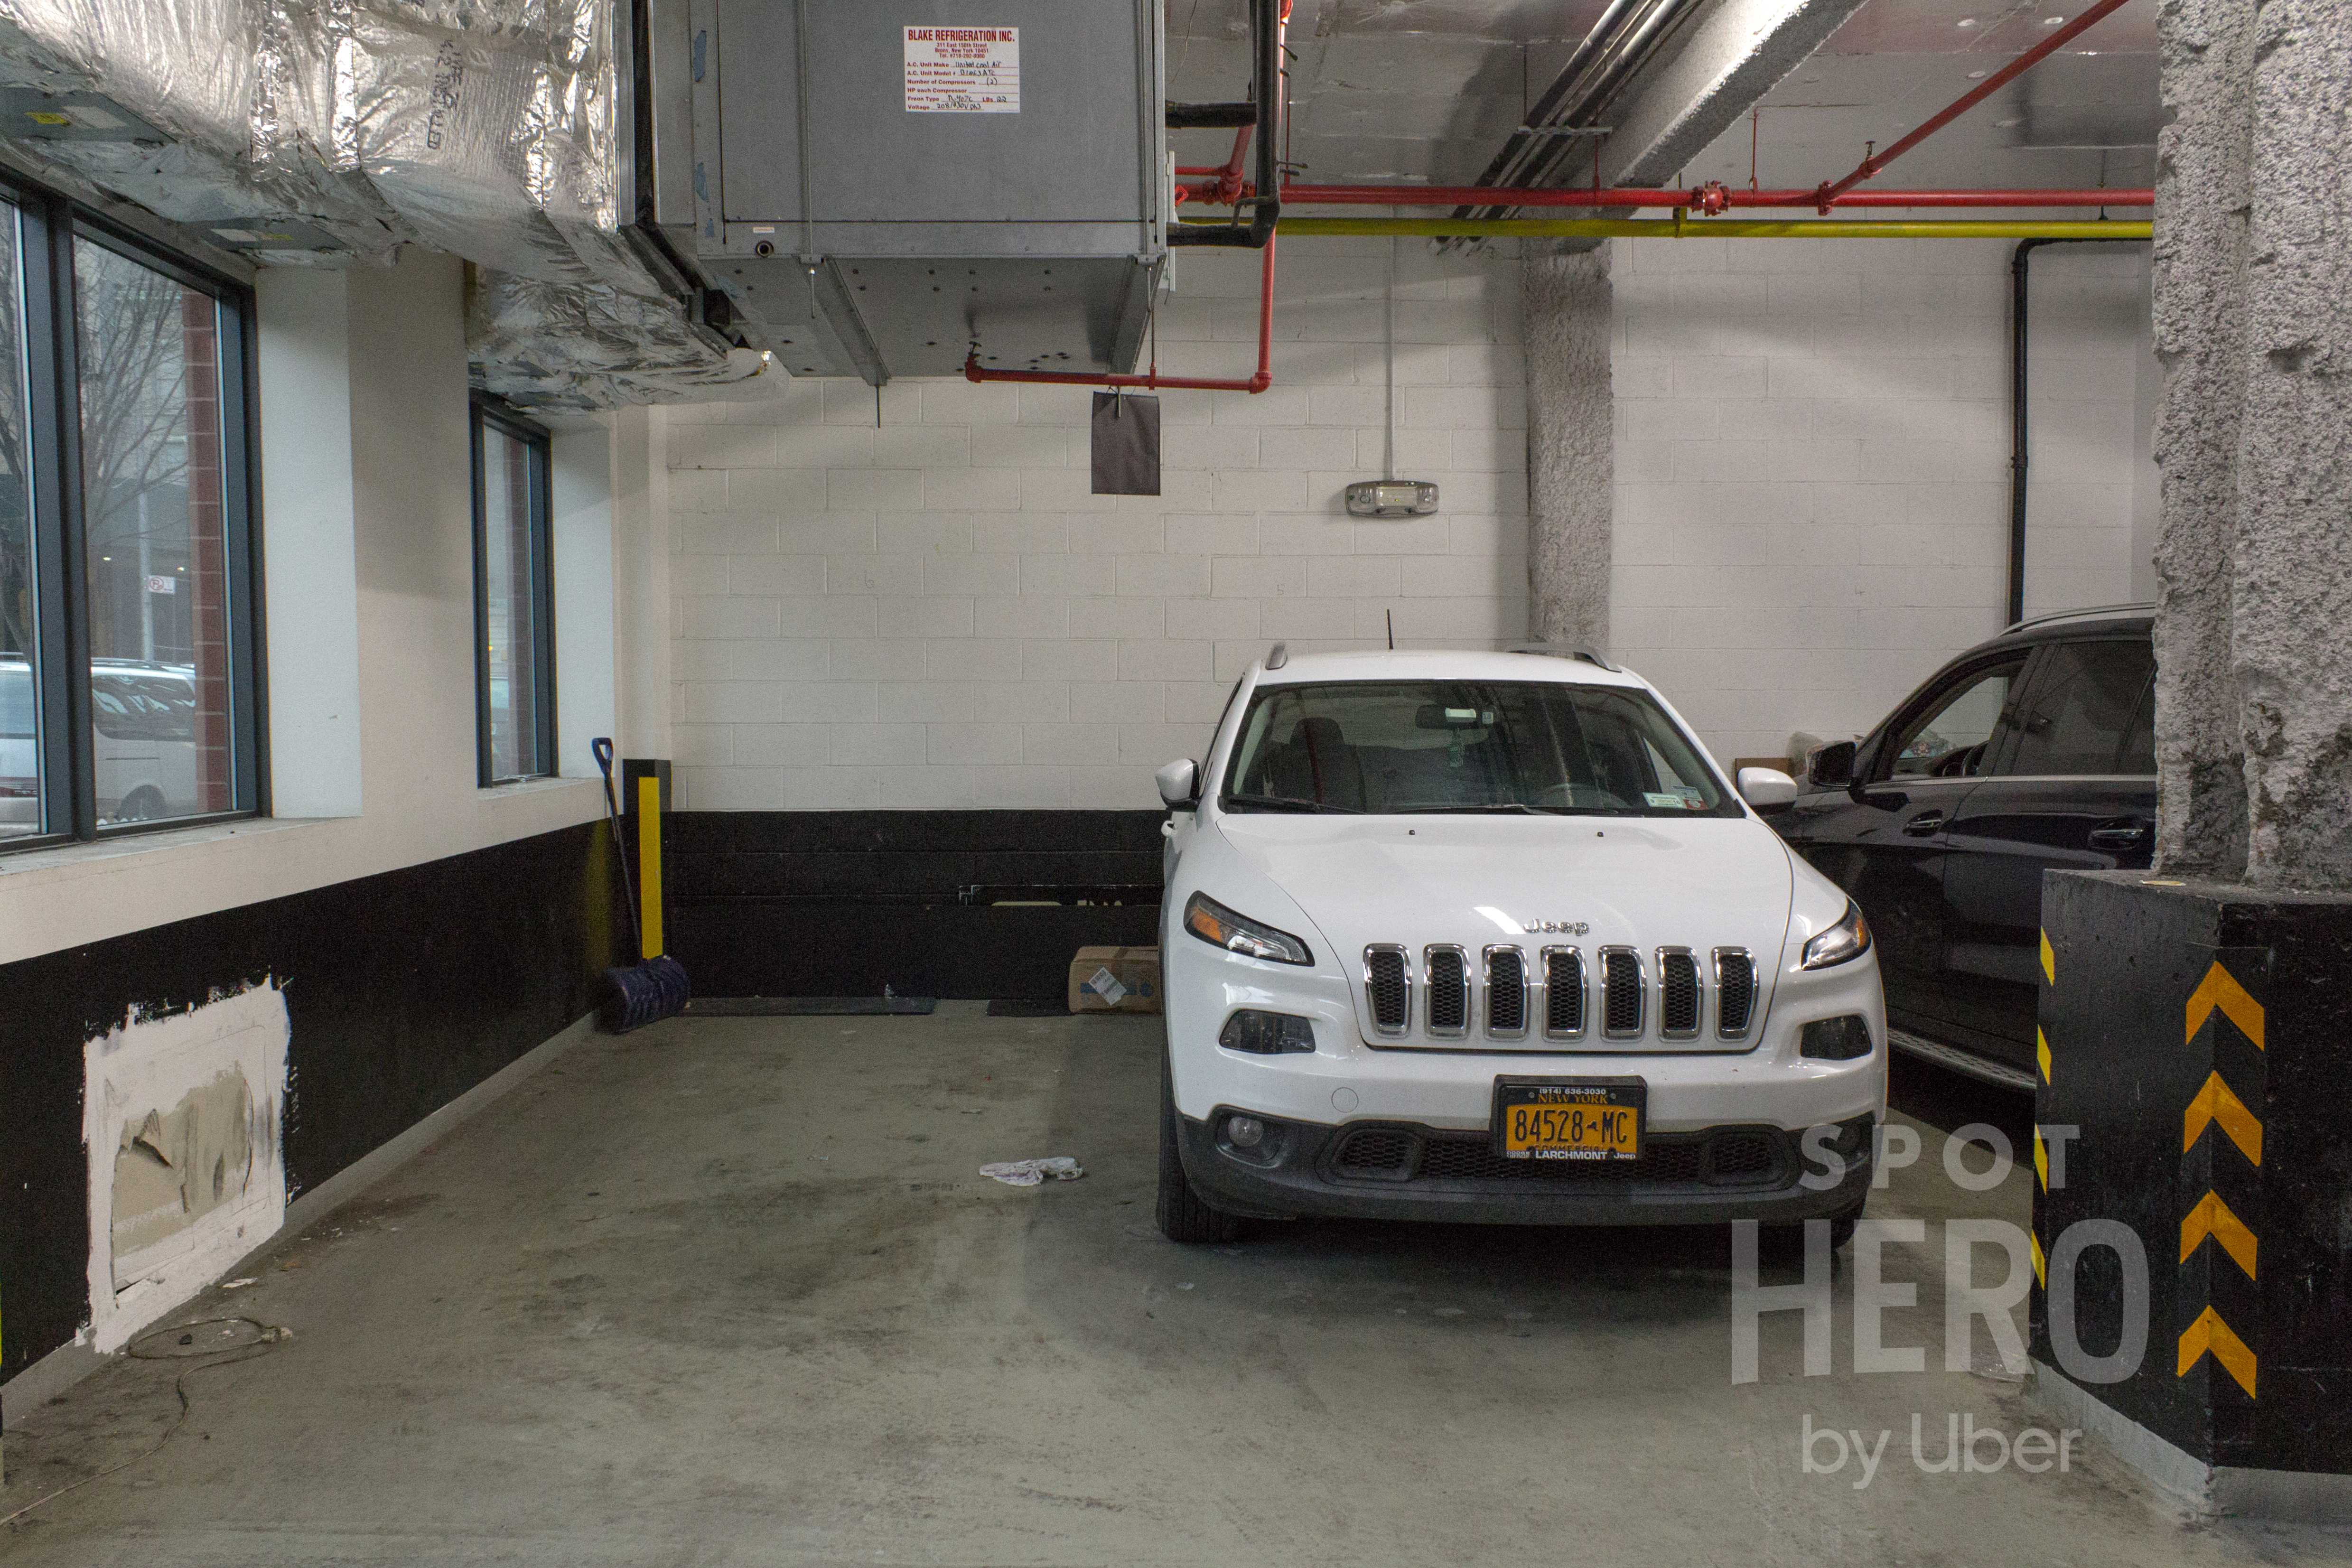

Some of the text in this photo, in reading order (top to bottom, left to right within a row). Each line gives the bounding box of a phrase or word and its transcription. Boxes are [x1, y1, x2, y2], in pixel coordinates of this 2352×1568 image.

[908, 29, 1015, 42] BLAKE REFRIGERATION INC.
[1523, 918, 1589, 936] Jeep
[1538, 1094, 1609, 1104] NEW YORK
[1514, 1109, 1628, 1144] 84528 MC
[1535, 1150, 1607, 1159] LARCHMONT
